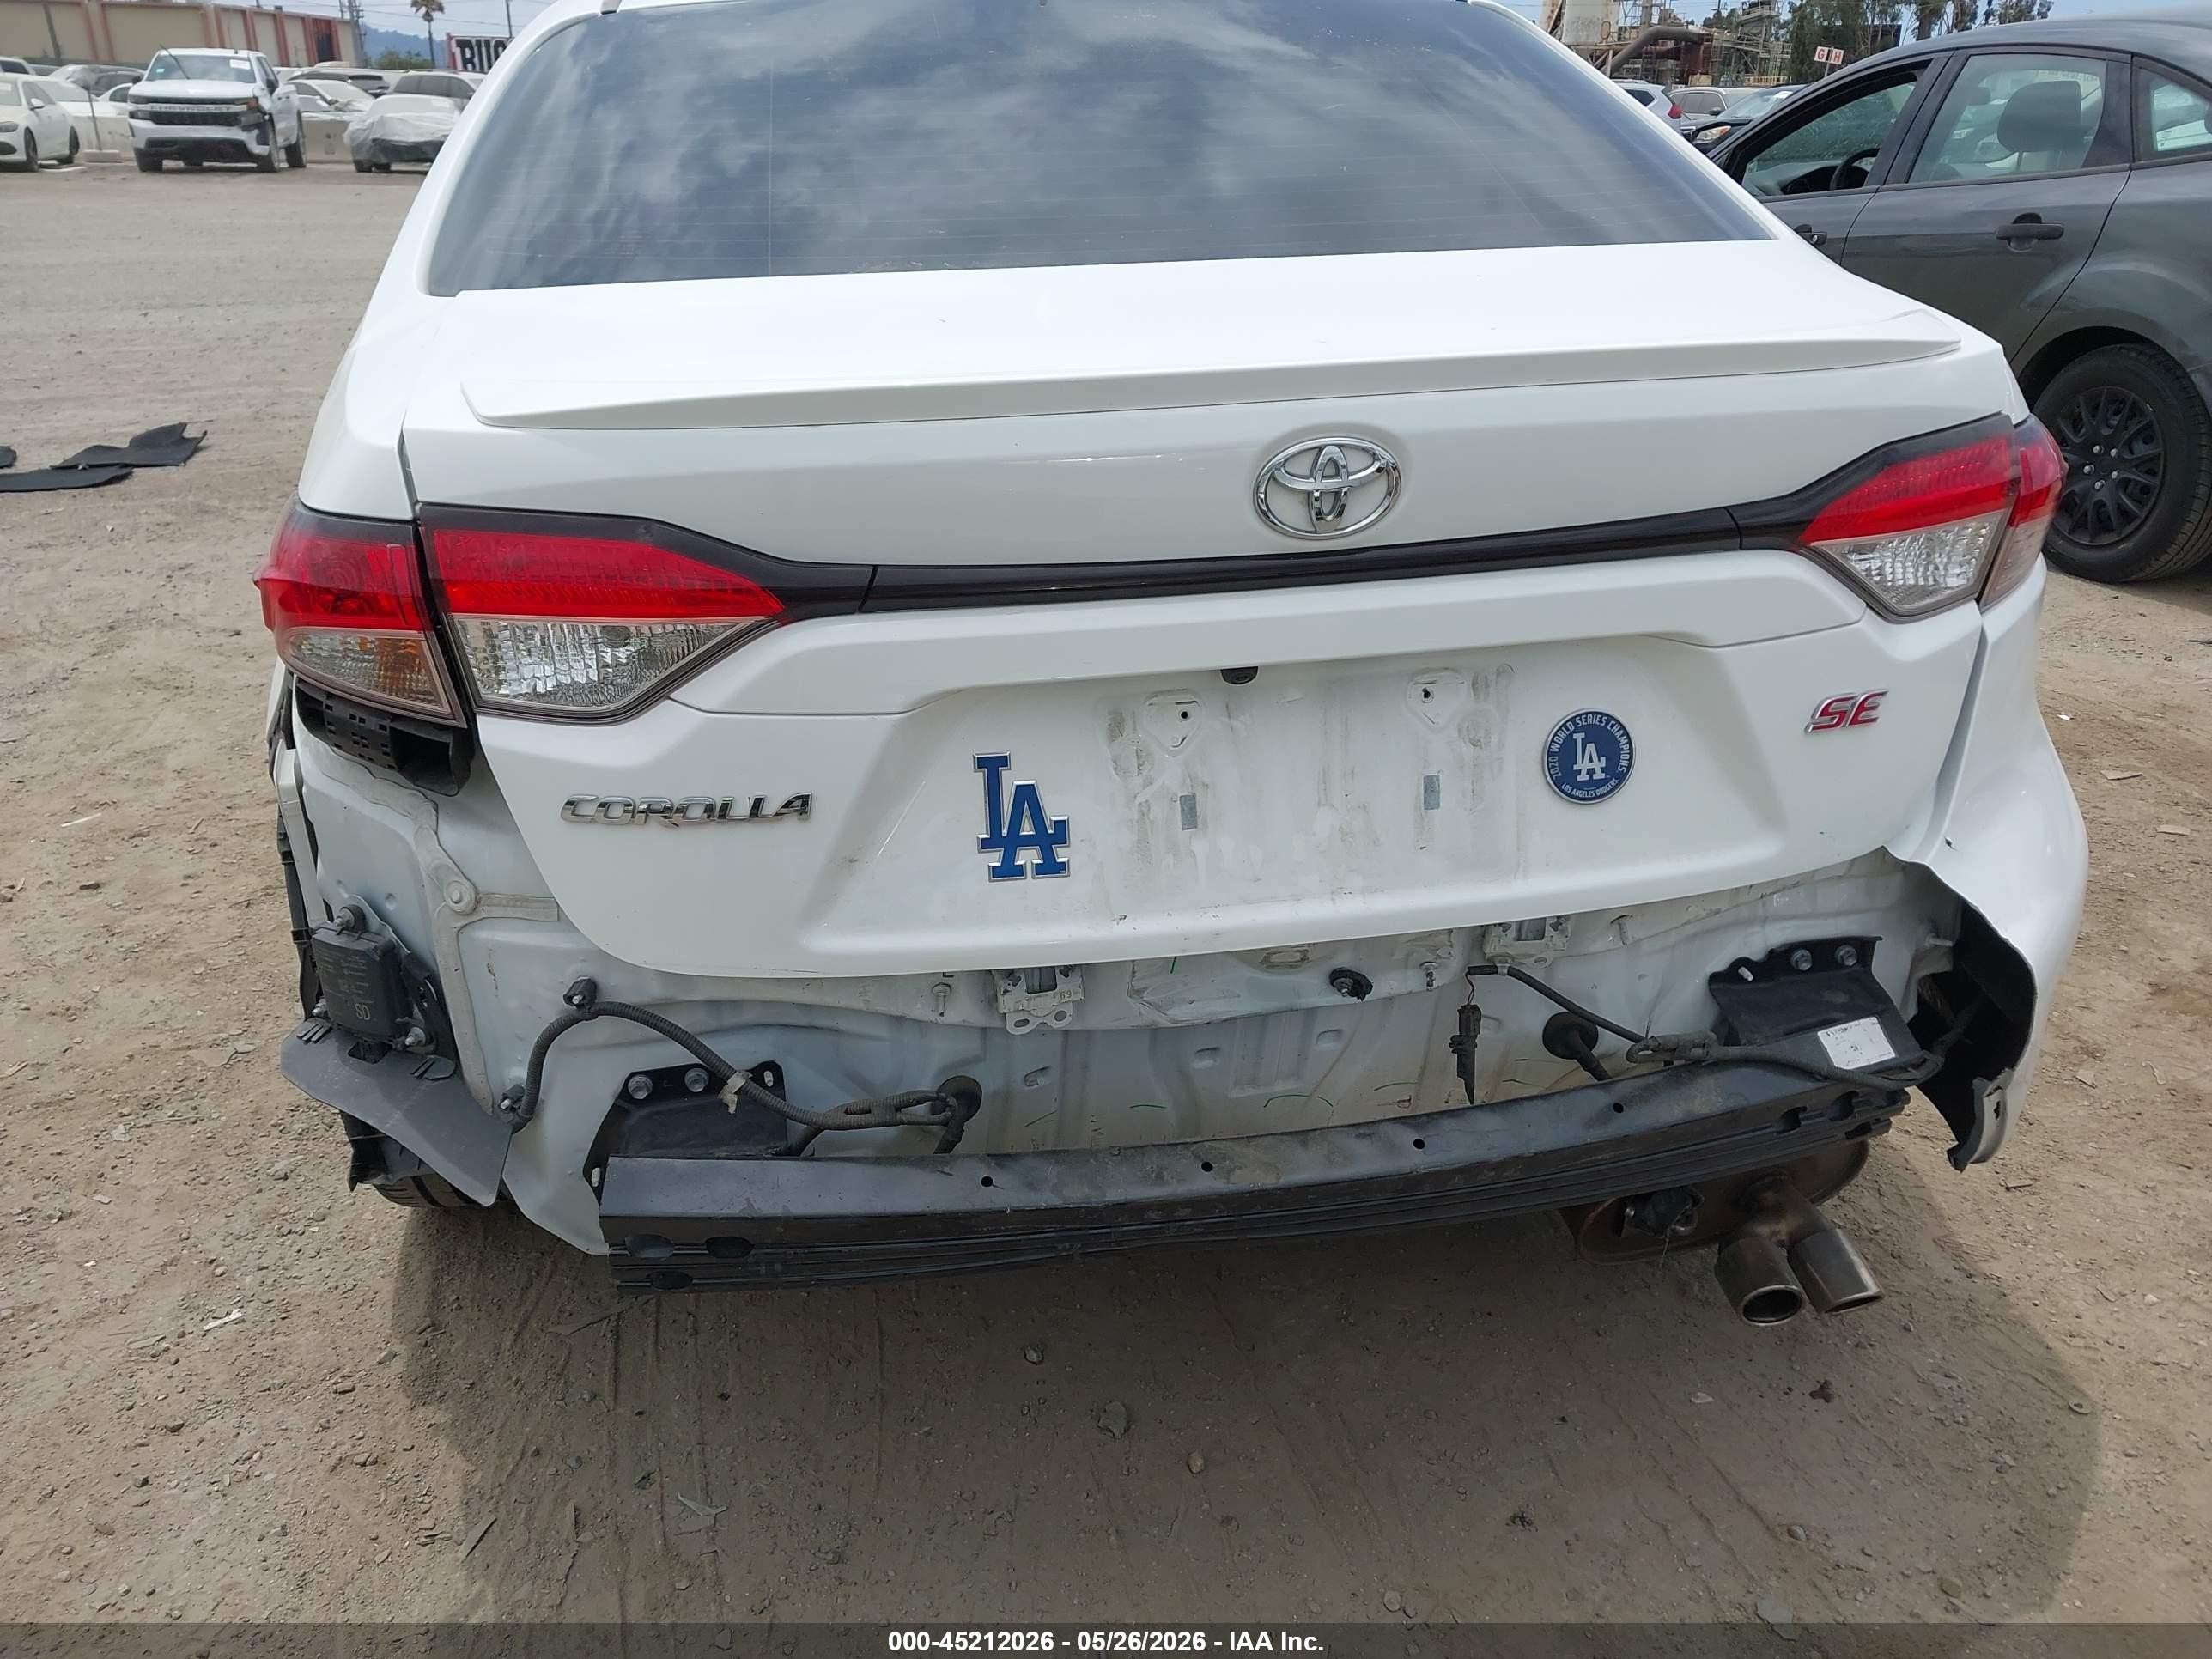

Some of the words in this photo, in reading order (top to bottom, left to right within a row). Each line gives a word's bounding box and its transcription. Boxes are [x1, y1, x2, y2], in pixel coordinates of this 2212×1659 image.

[1817, 48, 1826, 60] G
[1832, 51, 1842, 63] H
[1575, 714, 1608, 727] SERIES
[1804, 688, 1889, 733] SE
[1549, 721, 1575, 752] WORLD
[1607, 720, 1631, 773] CHAMPIONS
[1548, 756, 1562, 780] 2020
[1572, 732, 1607, 781] LA
[1561, 782, 1572, 793] LOS
[1571, 788, 1595, 798] ANGELES
[1595, 777, 1620, 796] DODGERS
[560, 793, 812, 827] COROLLA
[973, 751, 1071, 883] LA
